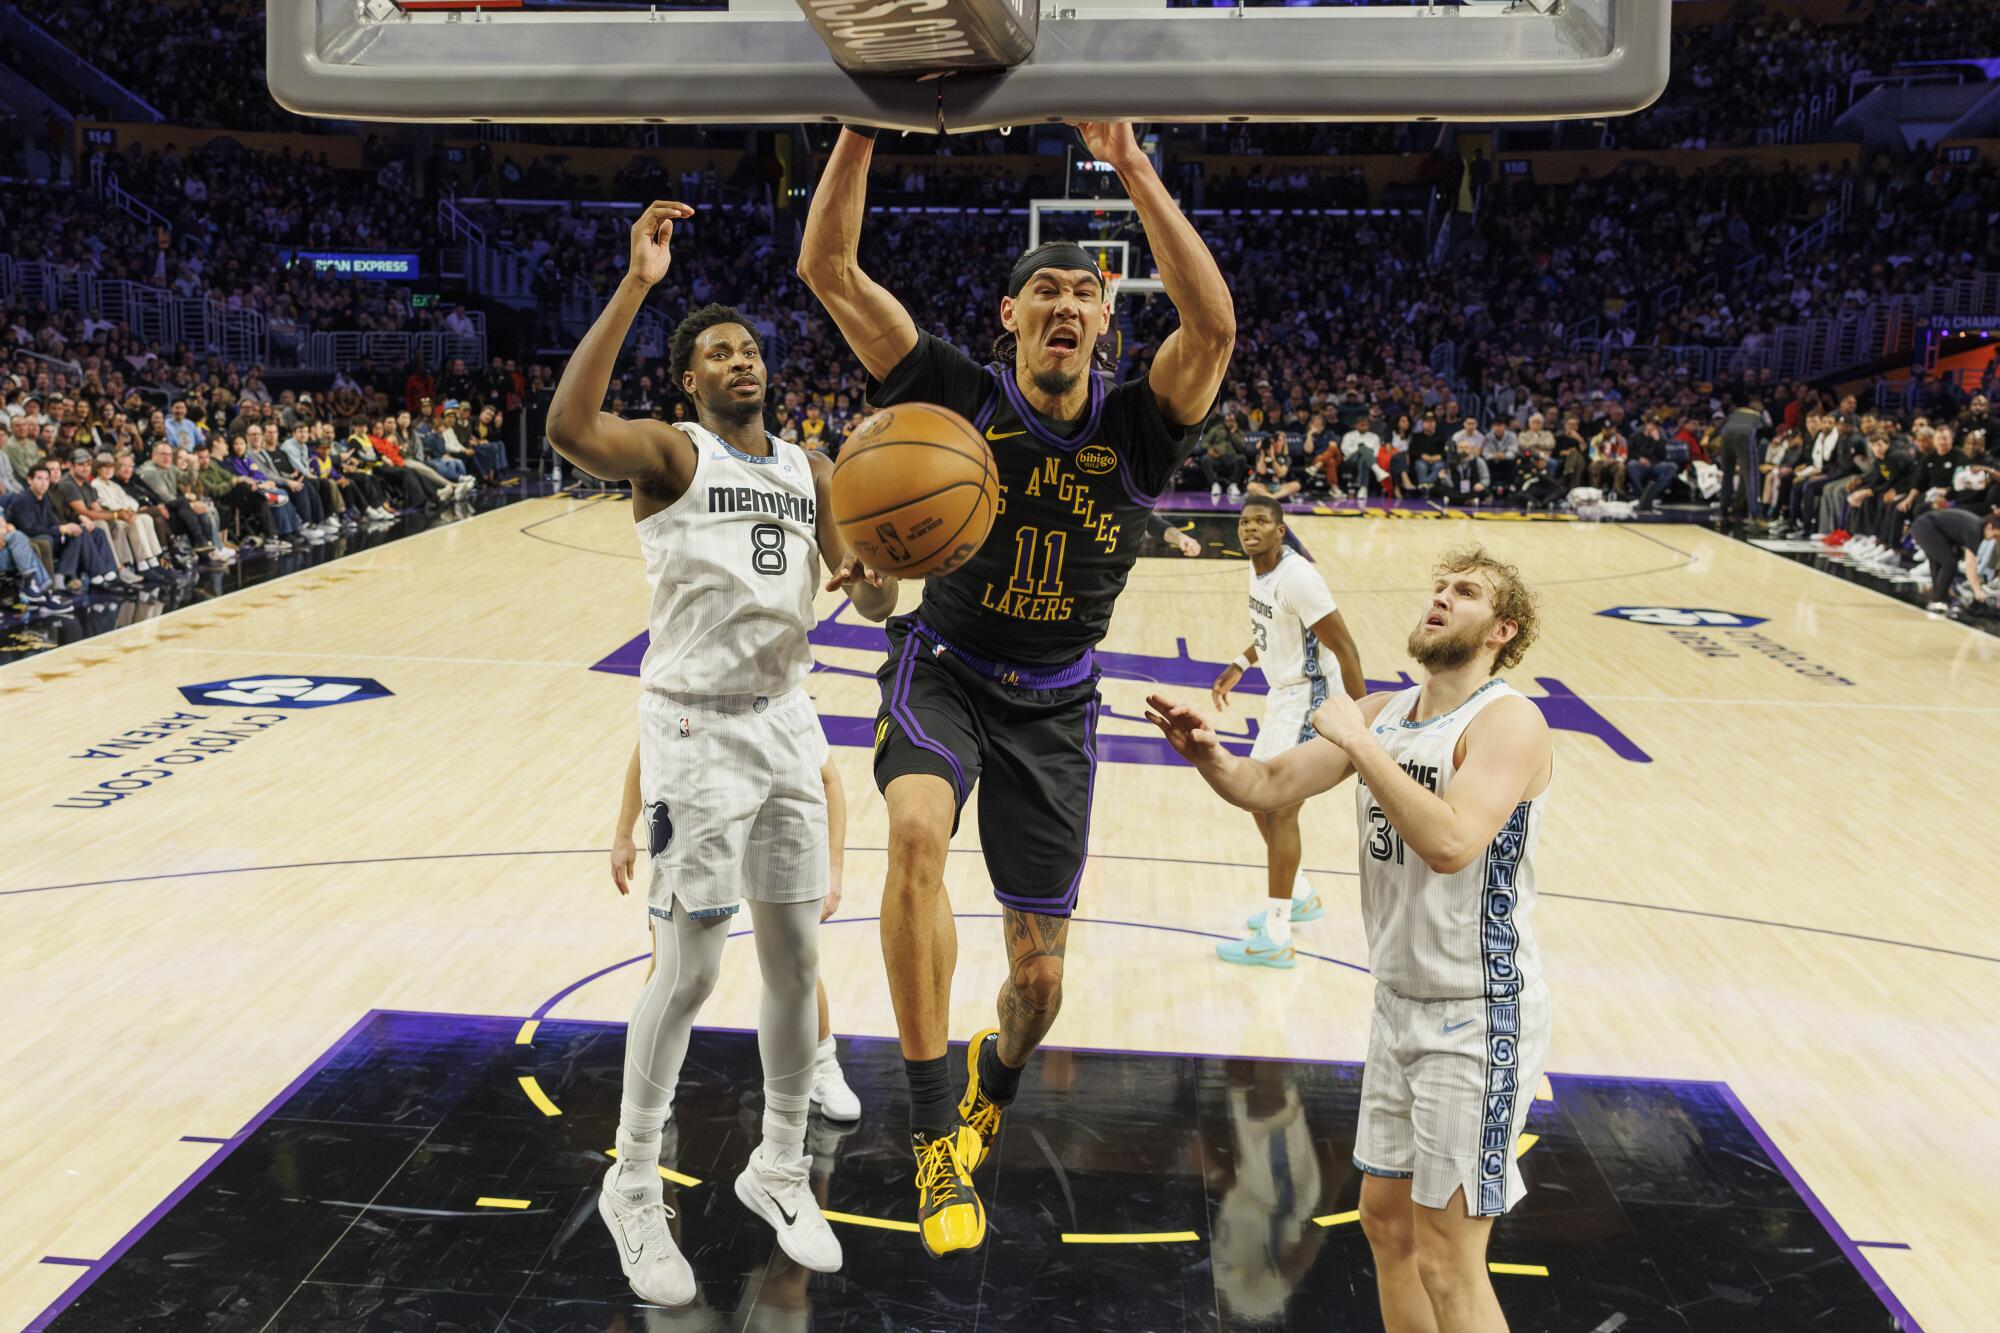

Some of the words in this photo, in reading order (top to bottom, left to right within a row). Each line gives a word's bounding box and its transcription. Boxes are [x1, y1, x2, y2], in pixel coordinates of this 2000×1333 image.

[809, 0, 975, 63] S.COM
[353, 260, 408, 272] EXPRESS
[1080, 452, 1115, 467] bibigo
[1025, 457, 1121, 554] ANGELES
[751, 523, 787, 575] 8
[1009, 525, 1067, 596] 11
[981, 583, 1075, 621] LAKERS
[53, 713, 288, 808] crypto.com
[69, 711, 210, 759] ARENA
